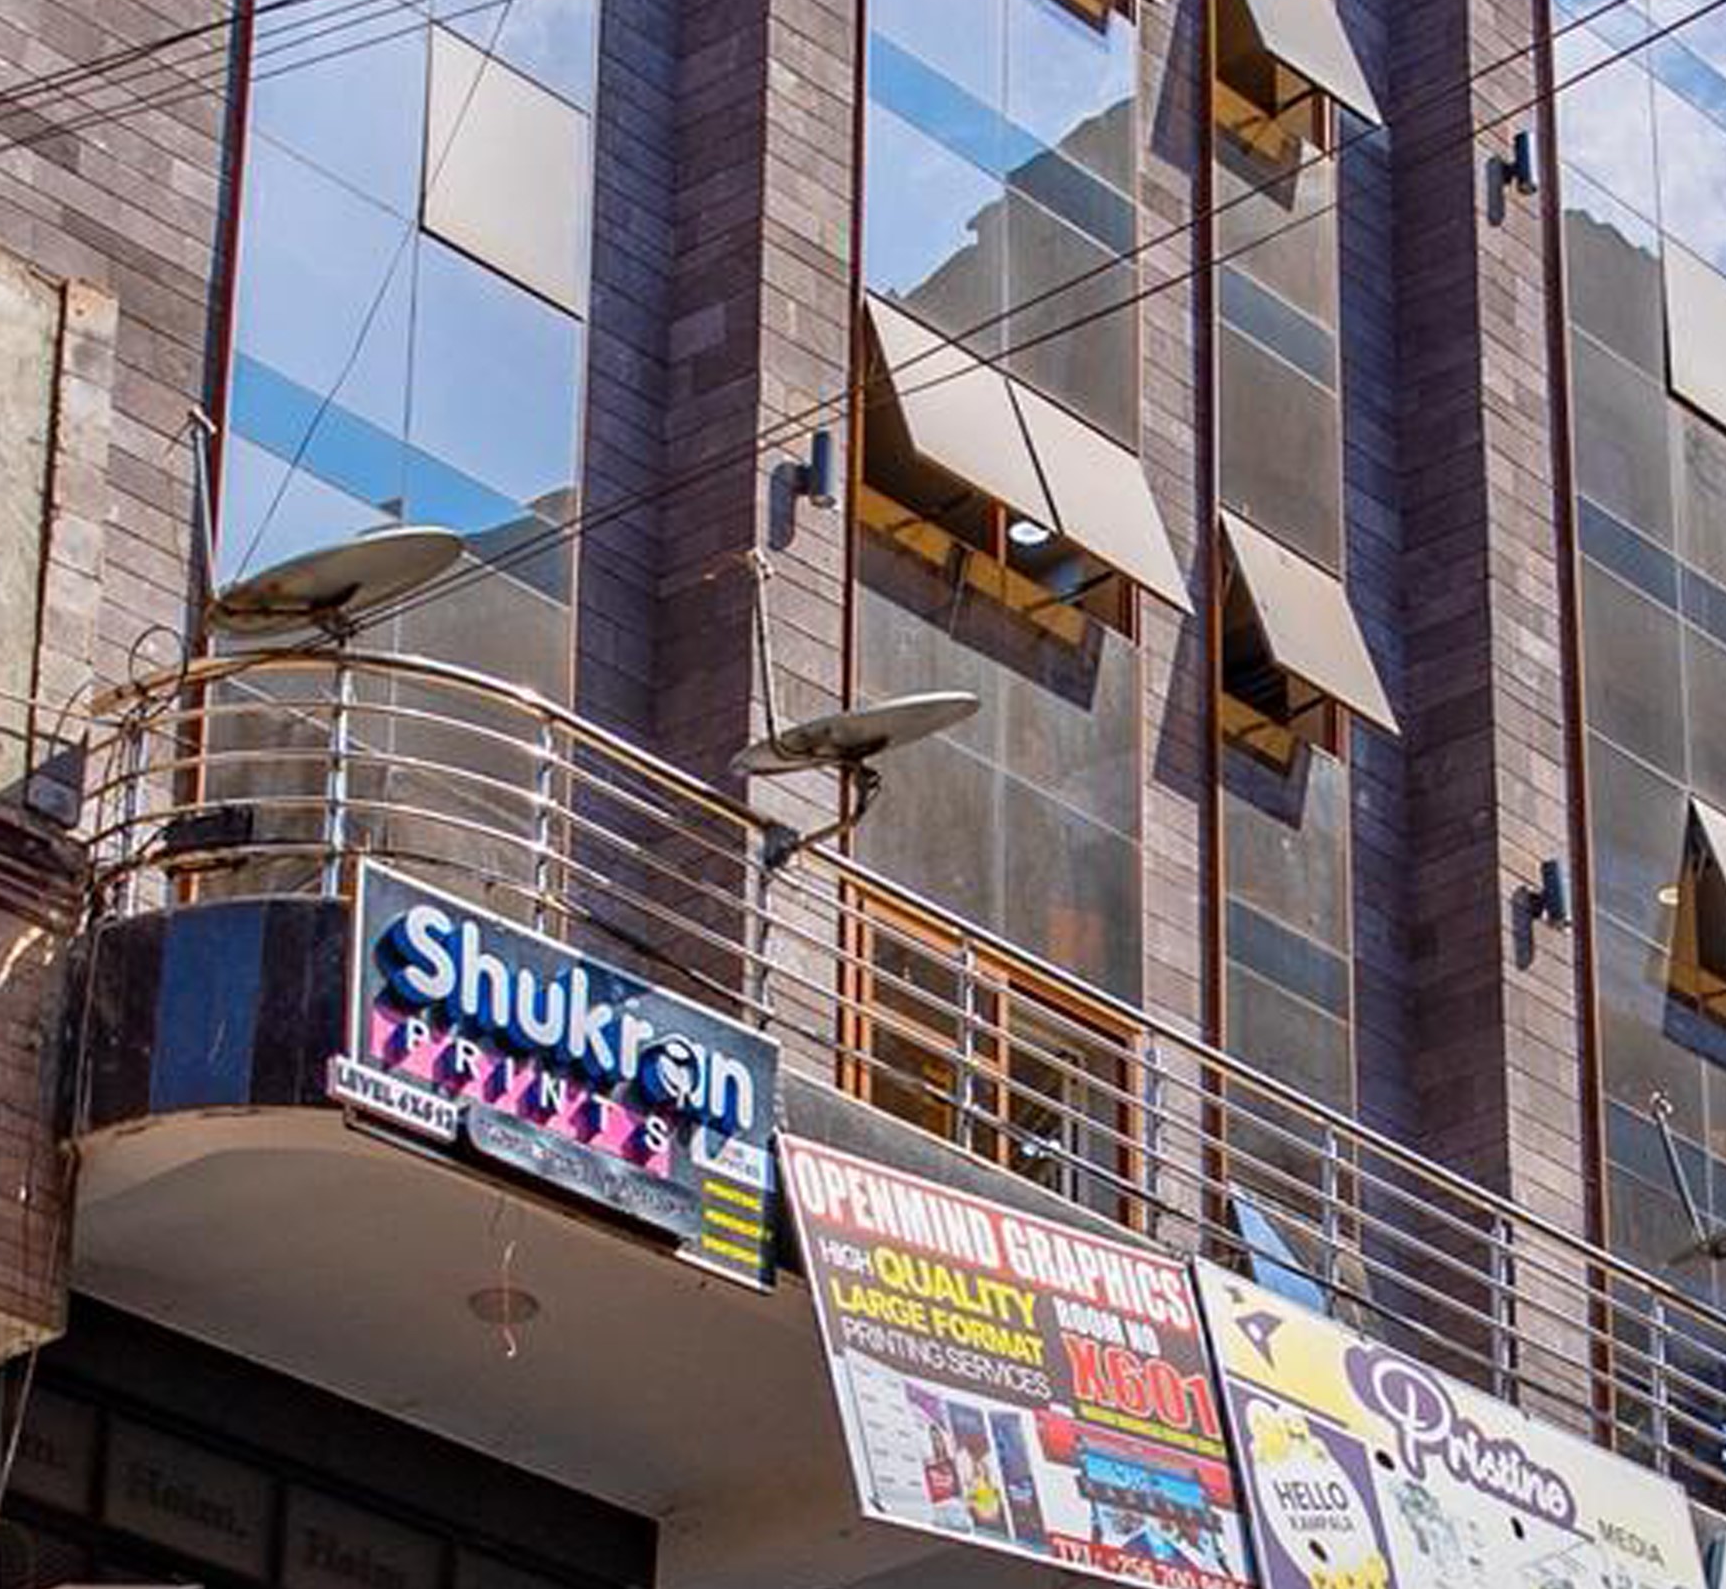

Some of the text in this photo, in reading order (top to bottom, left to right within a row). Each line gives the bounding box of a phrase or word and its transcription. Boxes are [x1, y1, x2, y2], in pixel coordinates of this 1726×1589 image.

[404, 1017, 670, 1152] PRINTS
[793, 1148, 997, 1266] OPENMIND
[1002, 1216, 1192, 1330] GRAPHICS
[819, 1237, 874, 1278] HIGH
[874, 1246, 1036, 1328] QUALITY
[830, 1277, 1045, 1367] LARGE FORMAT
[840, 1316, 1053, 1401] PRINTING SERVICES
[1273, 1480, 1349, 1511] HELLO
